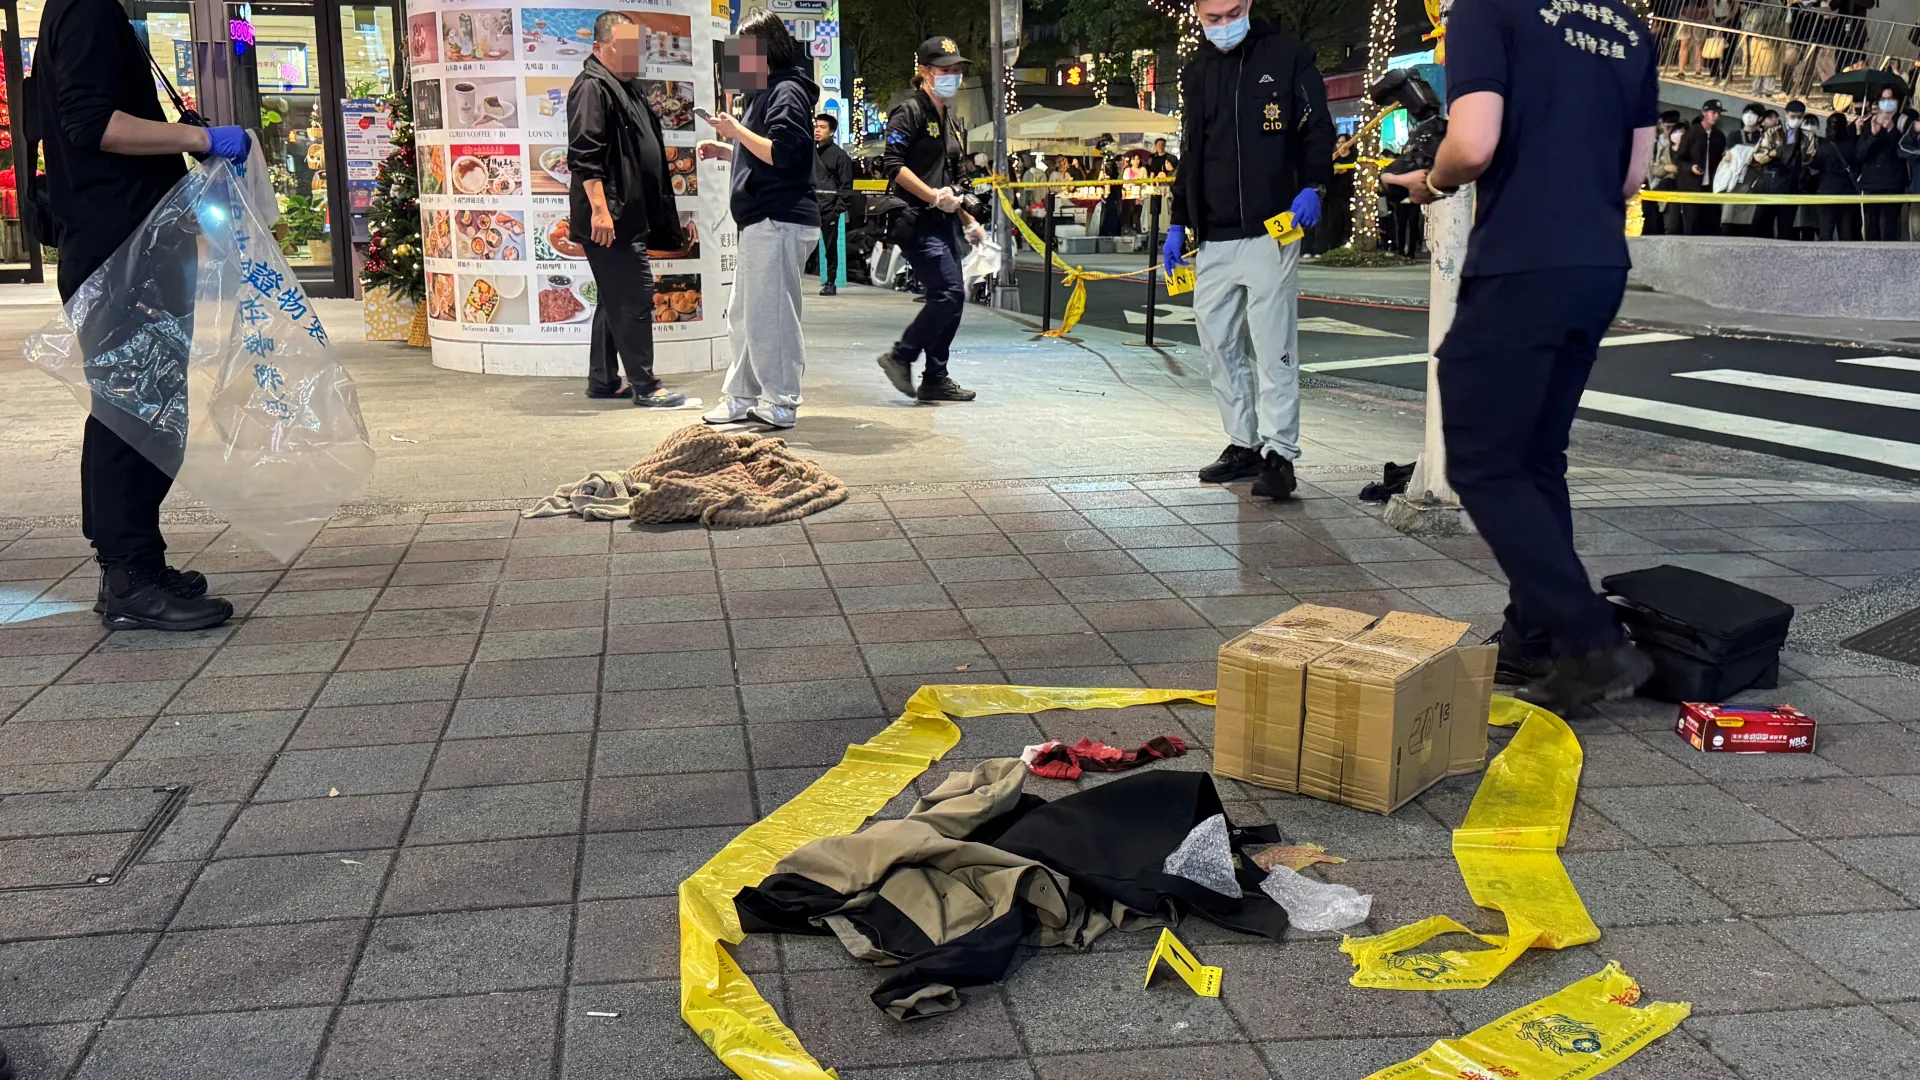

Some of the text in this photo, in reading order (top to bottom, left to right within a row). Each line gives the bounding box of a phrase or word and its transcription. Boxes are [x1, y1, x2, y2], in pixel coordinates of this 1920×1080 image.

[1262, 121, 1283, 131] CID
[1273, 219, 1285, 233] 3
[1176, 274, 1186, 285] 2
[1788, 735, 1808, 748] NBR
[1168, 943, 1195, 973] 1
